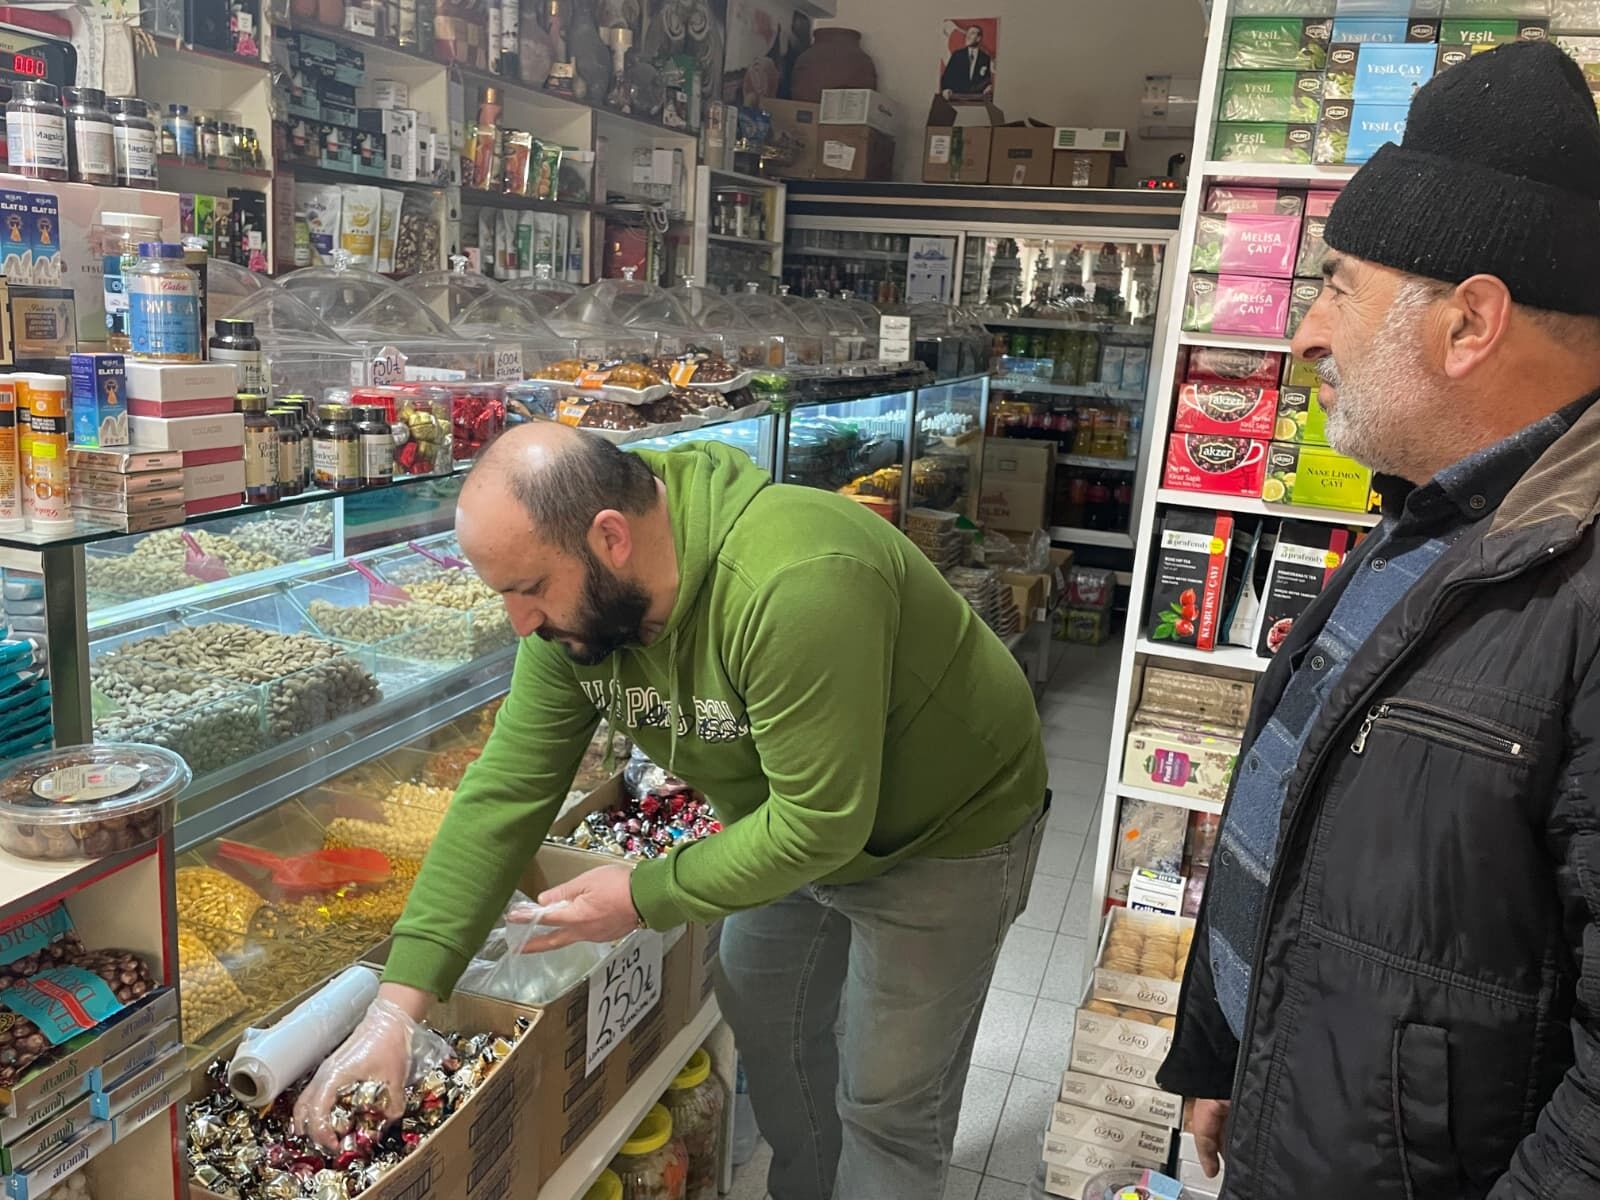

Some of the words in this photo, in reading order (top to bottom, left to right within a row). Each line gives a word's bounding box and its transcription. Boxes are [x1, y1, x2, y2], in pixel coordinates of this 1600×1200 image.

[1459, 30, 1495, 43] YEŞİL
[1367, 64, 1397, 75] YEŞİL
[1398, 63, 1424, 76] ÇAY
[1361, 120, 1392, 132] YEŞİL
[1241, 231, 1281, 244] MELİSA
[1247, 243, 1273, 255] ÇAYI
[1239, 304, 1264, 315] ÇAYI
[1212, 395, 1241, 406] akzer
[1203, 446, 1232, 458] akzer
[1140, 1130, 1165, 1144] Fincan
